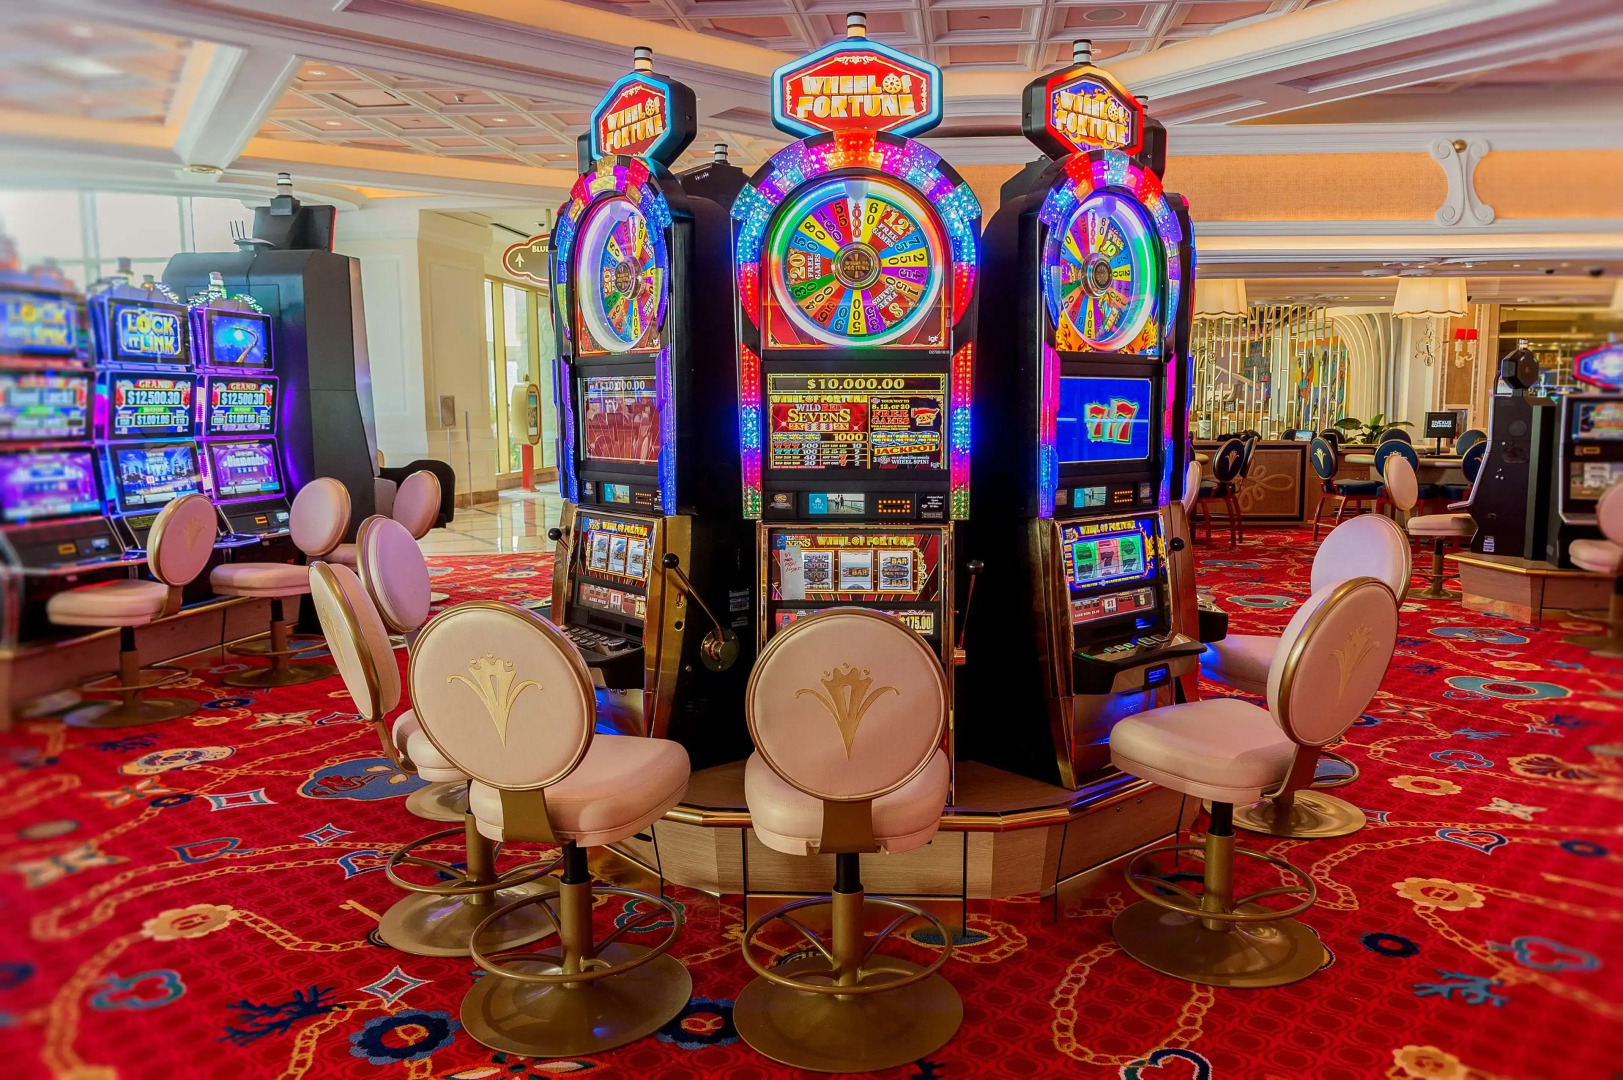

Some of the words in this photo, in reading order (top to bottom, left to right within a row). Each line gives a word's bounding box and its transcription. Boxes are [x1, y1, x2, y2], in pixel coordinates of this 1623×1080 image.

[801, 75, 882, 95] WHEEL
[797, 94, 916, 118] FORTUNE
[1060, 91, 1108, 119] WHEEL
[607, 103, 645, 131] WHEEL
[606, 114, 664, 152] FORTUNE
[1056, 110, 1126, 145] FORTUNE
[834, 202, 848, 227] 55
[866, 202, 879, 226] 60
[883, 211, 910, 236] 12
[804, 222, 826, 240] 80
[872, 227, 894, 248] GAMES
[878, 222, 899, 242] FREE
[793, 235, 819, 252] 50
[894, 235, 922, 252] 75
[789, 253, 806, 279] 20
[888, 253, 925, 266] 250
[884, 276, 919, 296] 150
[127, 312, 174, 335] LOCK
[852, 298, 862, 334] 500
[129, 338, 140, 348] IT
[140, 334, 176, 354] LINK
[138, 380, 170, 389] GRAND
[807, 378, 905, 390] $10,000.00
[795, 404, 821, 412] WILD
[822, 404, 842, 412] RED
[820, 395, 868, 403] FORTUNE
[787, 408, 851, 422] SEVENS
[876, 444, 934, 454] JACKPOT
[817, 536, 850, 546] WHEEL
[866, 536, 916, 546] FORTUNE
[1140, 595, 1146, 606] 5
